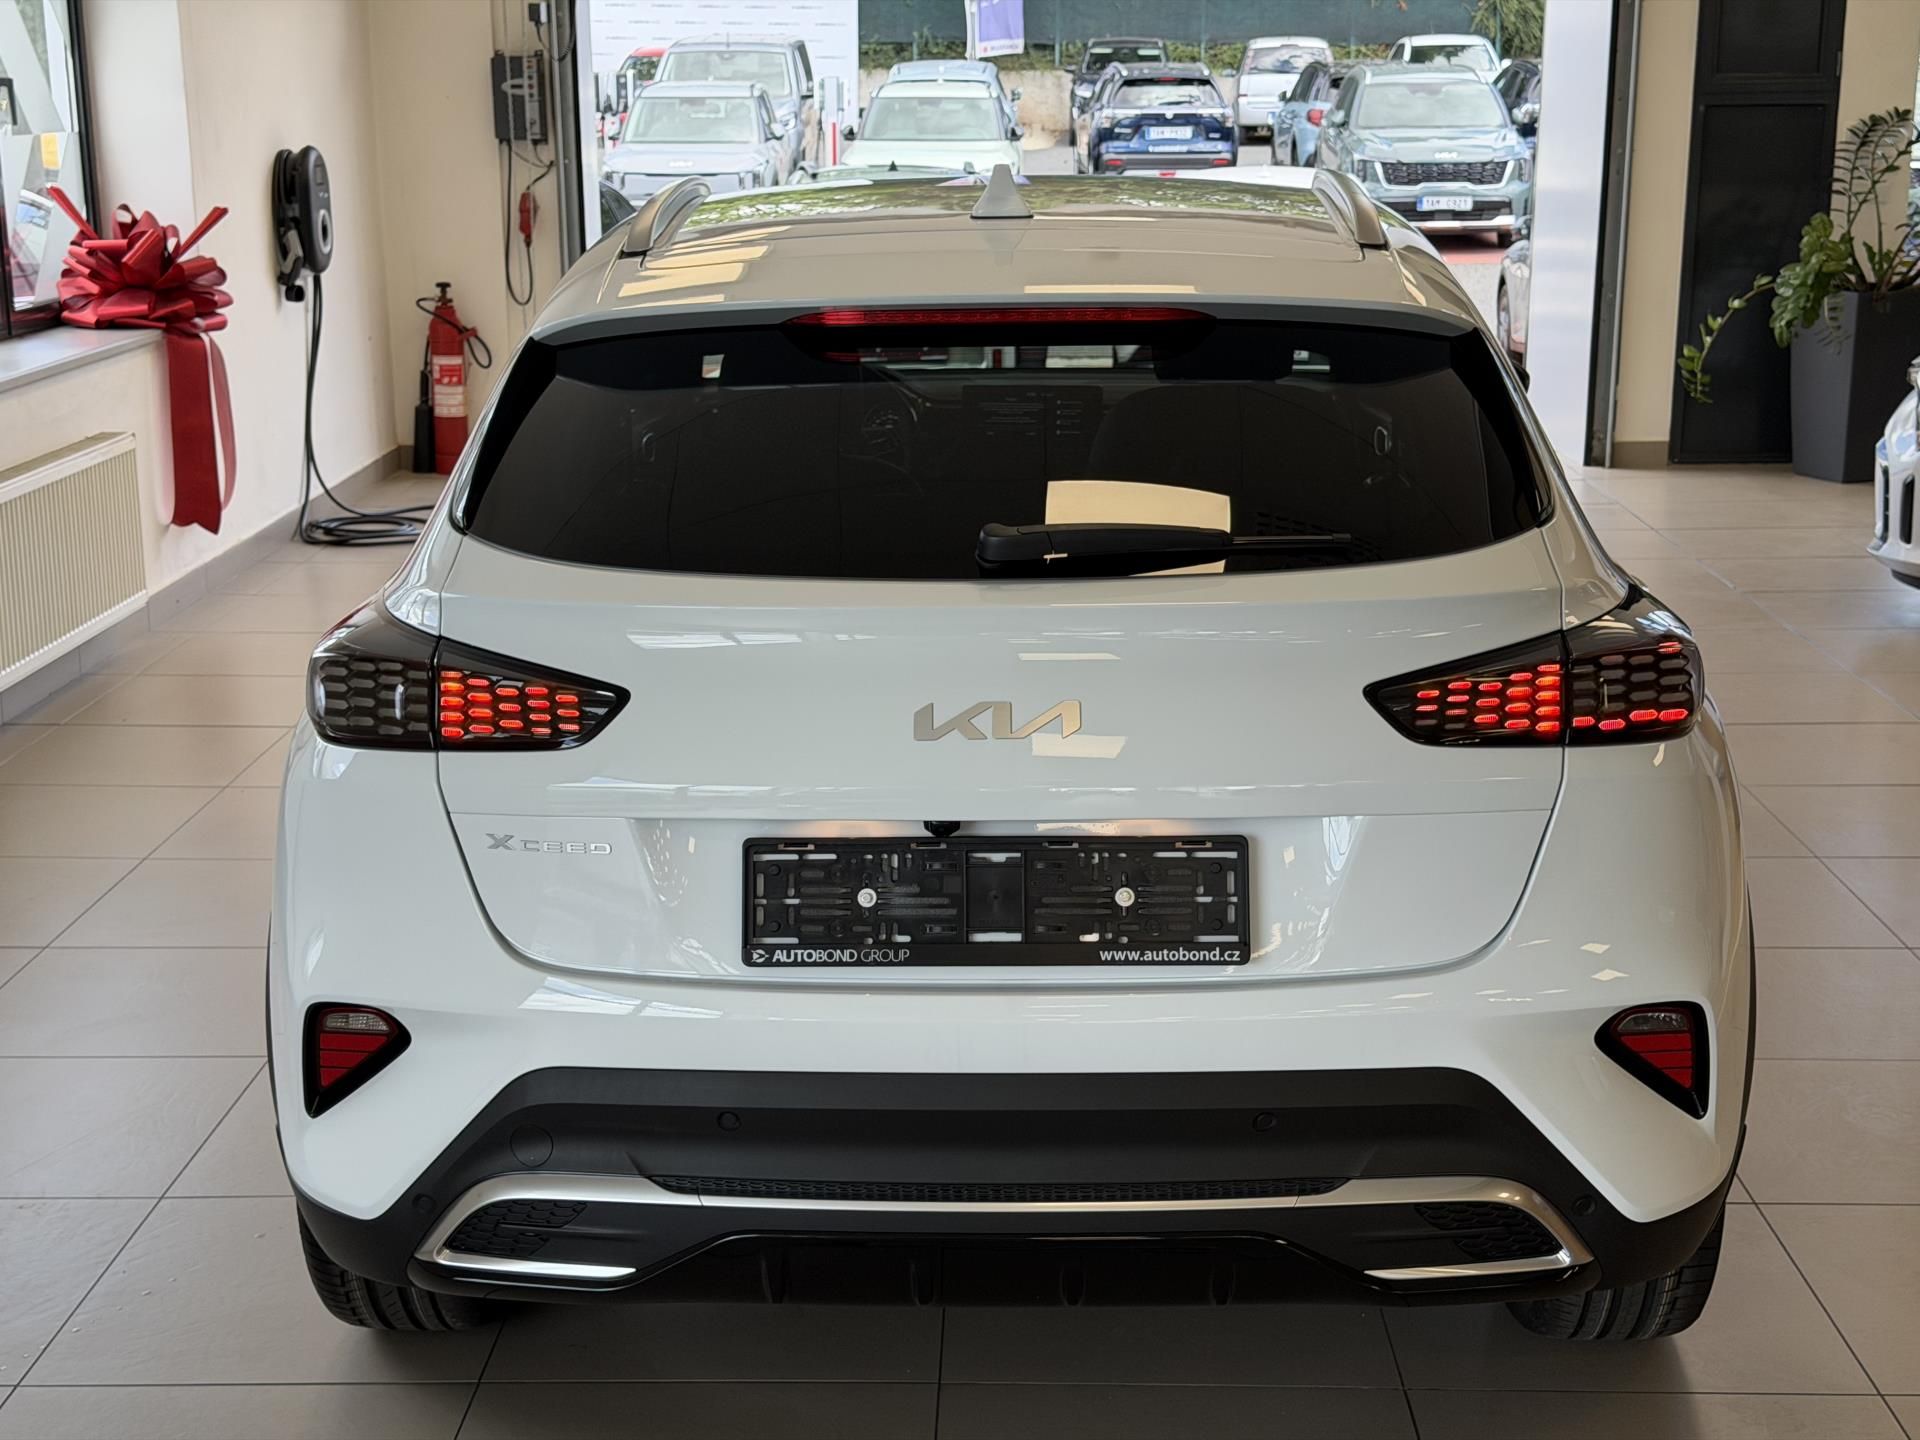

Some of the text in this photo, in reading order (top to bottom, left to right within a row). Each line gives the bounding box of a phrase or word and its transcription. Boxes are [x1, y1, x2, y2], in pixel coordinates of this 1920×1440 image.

[913, 700, 1081, 741] KIA
[485, 832, 613, 855] XCEED
[772, 949, 909, 962] AUTOBOND GROUP
[1099, 946, 1241, 961] www.autobond.cz
